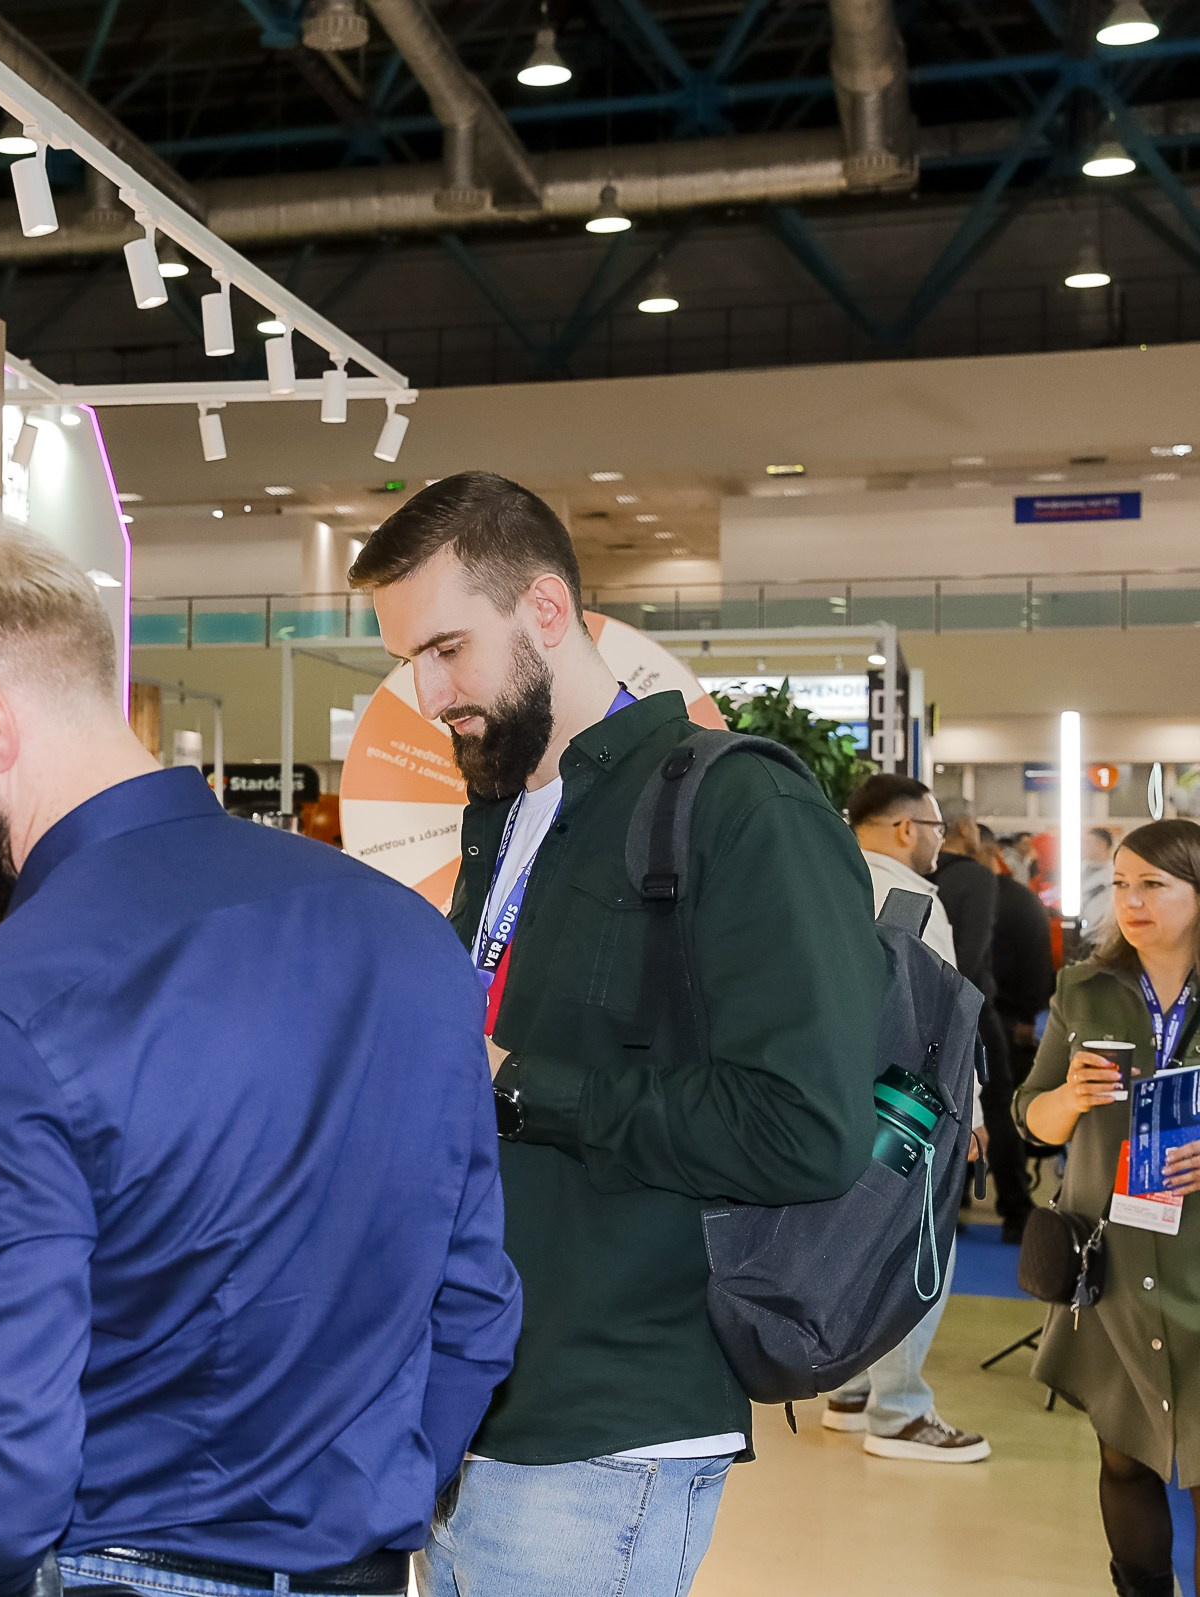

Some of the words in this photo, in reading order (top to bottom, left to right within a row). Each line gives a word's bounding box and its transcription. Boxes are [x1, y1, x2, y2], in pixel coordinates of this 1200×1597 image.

[1097, 767, 1110, 788] 1
[419, 823, 458, 842] десерт
[360, 839, 406, 856] подарок
